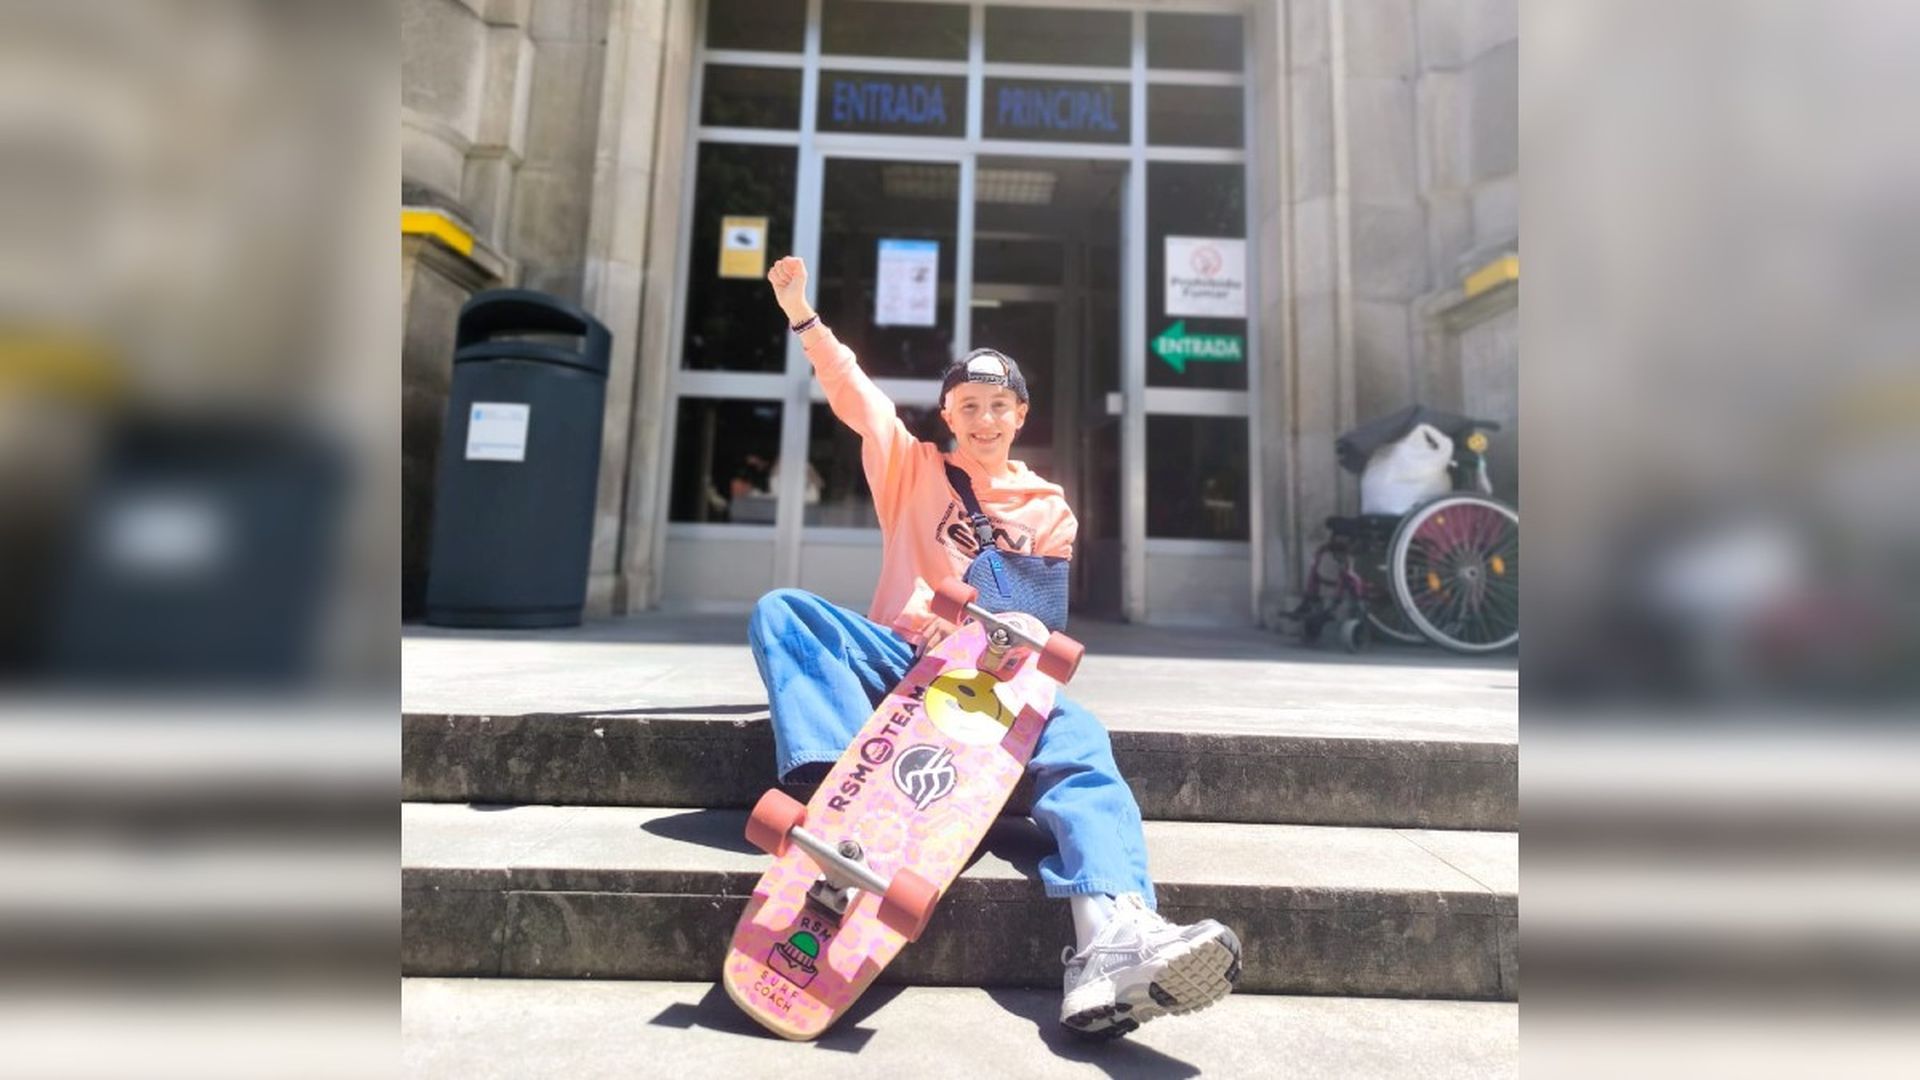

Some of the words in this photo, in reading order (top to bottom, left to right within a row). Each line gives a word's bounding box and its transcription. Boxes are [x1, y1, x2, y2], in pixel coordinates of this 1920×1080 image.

[832, 80, 947, 125] ENTRADA
[997, 87, 1119, 132] PRINCIPAL
[1158, 336, 1242, 360] ENTRADA
[828, 763, 873, 812] RSM
[880, 685, 925, 737] TEAM
[800, 916, 832, 942] RSM
[754, 982, 792, 1012] COACH
